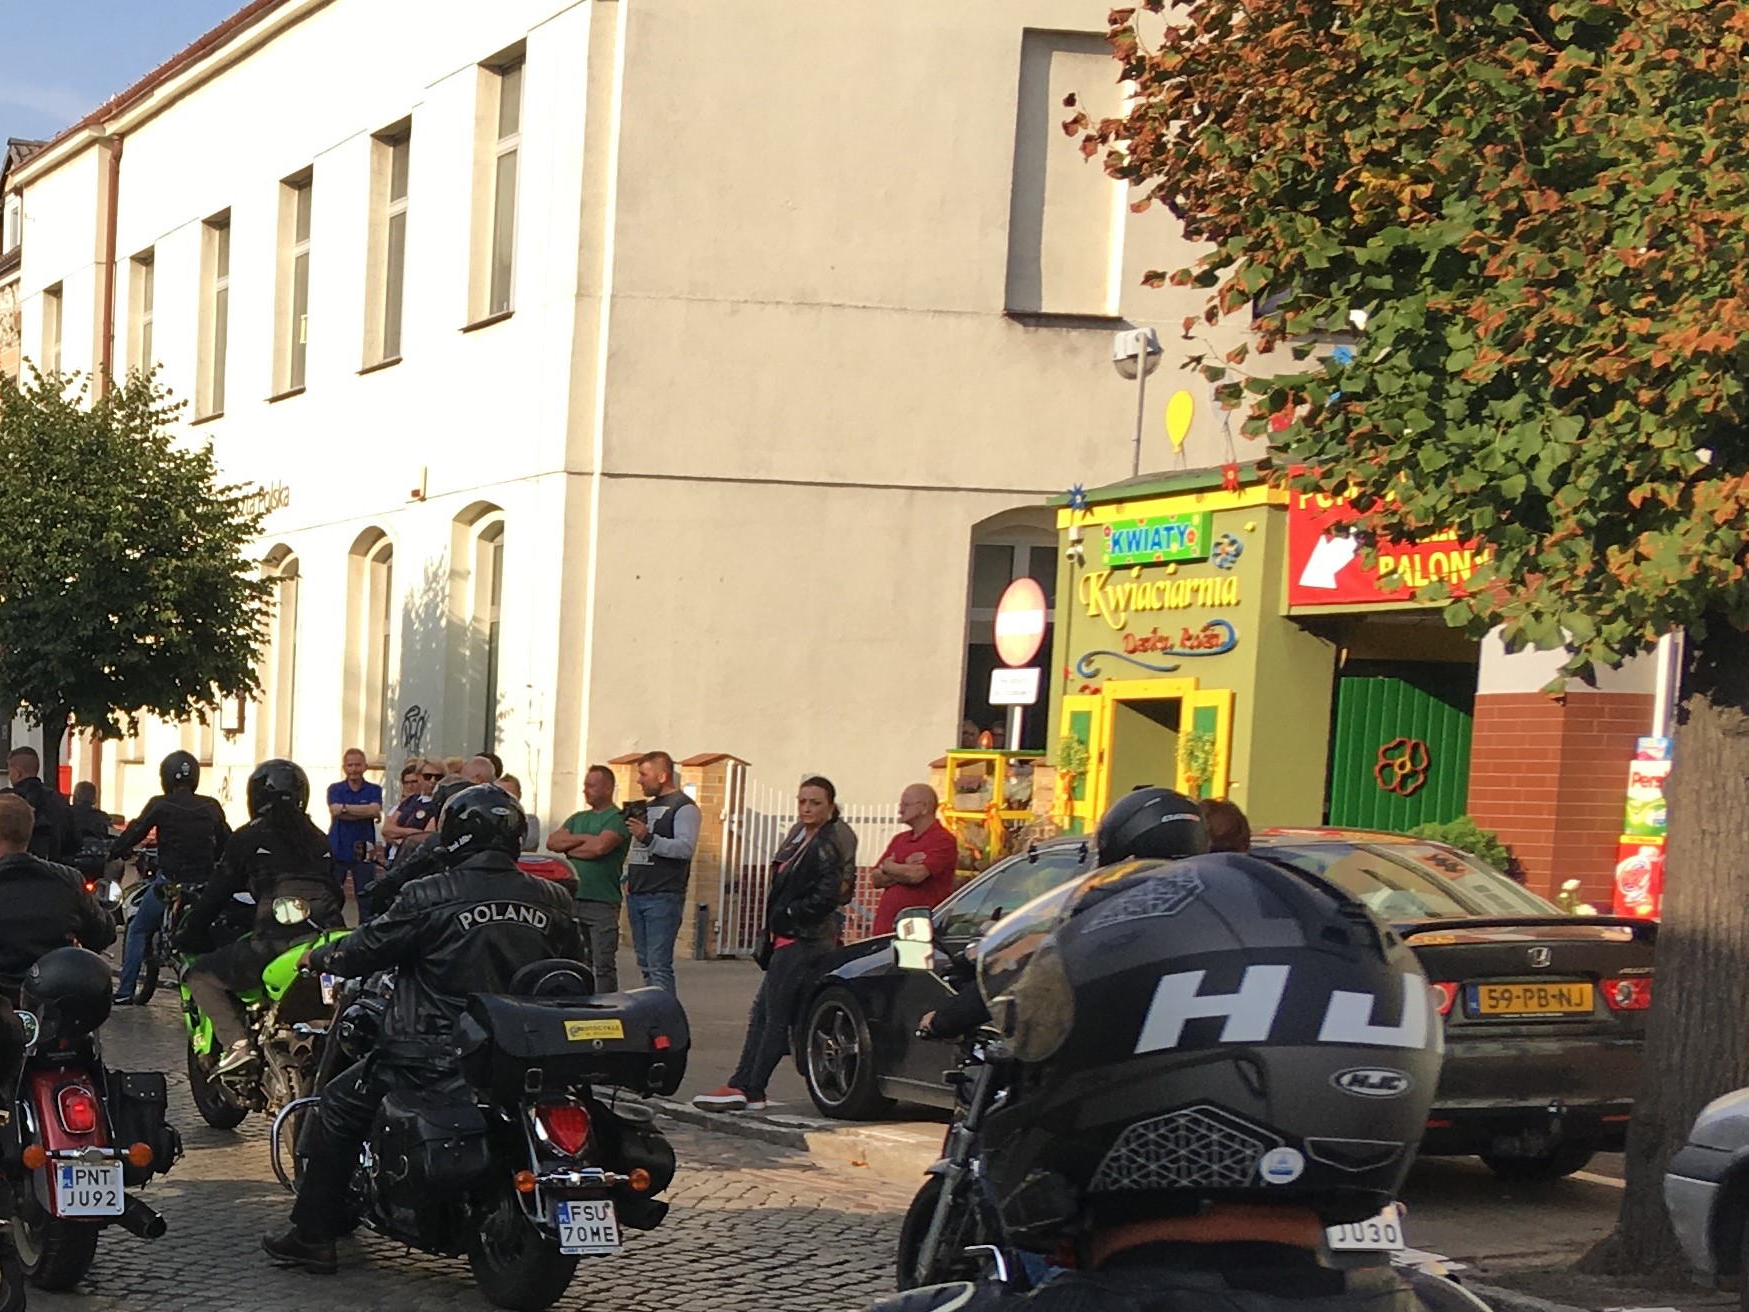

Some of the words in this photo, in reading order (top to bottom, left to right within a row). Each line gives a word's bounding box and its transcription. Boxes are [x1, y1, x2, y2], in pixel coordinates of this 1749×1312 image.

[1111, 524, 1189, 554] KWIATY
[1078, 563, 1239, 630] Kwiaciarnia
[458, 904, 547, 930] POLAND
[1487, 988, 1584, 1009] 59-PB-NJ
[1347, 1074, 1402, 1090] HJC
[76, 1169, 110, 1185] PNT
[67, 1191, 116, 1207] JU92
[570, 1205, 608, 1221] FSU
[563, 1226, 614, 1242] 70ME
[1338, 1223, 1397, 1243] JU30
